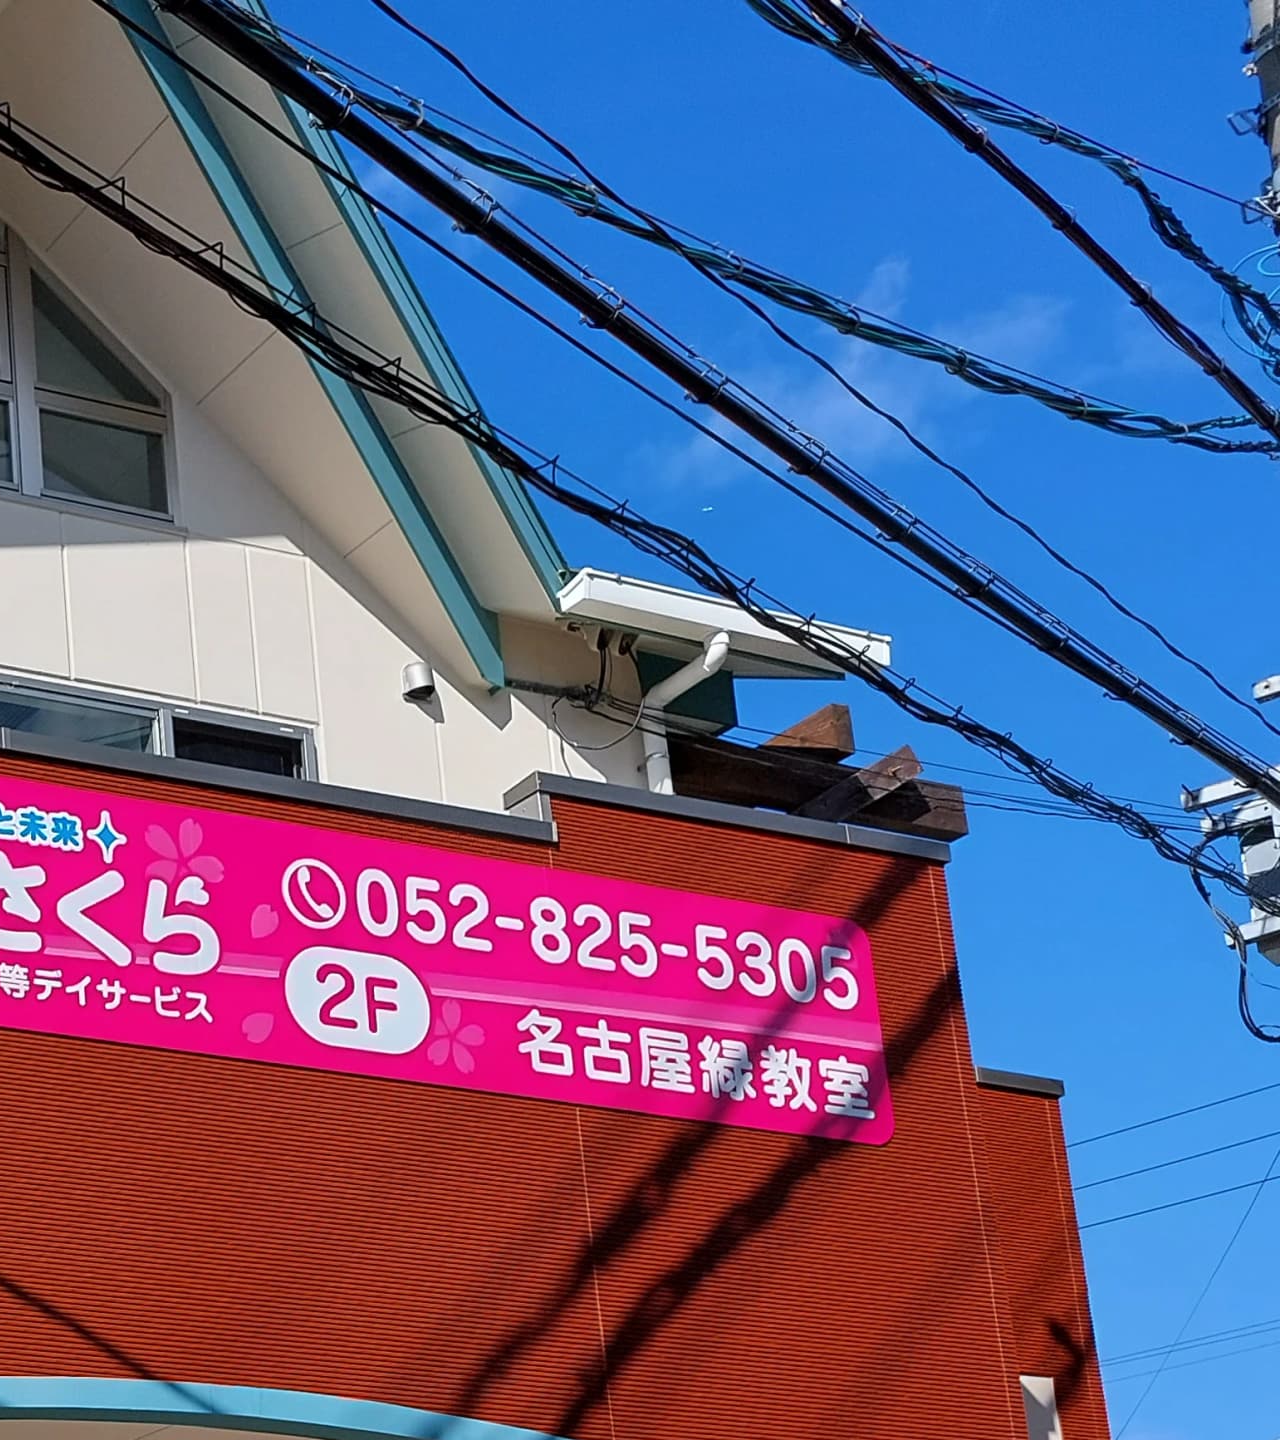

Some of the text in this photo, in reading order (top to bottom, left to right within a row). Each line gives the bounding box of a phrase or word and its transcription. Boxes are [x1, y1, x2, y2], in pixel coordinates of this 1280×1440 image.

[356, 867, 861, 1010] 052-825-5305
[315, 962, 398, 1034] 2F
[516, 1009, 878, 1122] 名古屋緑教室
